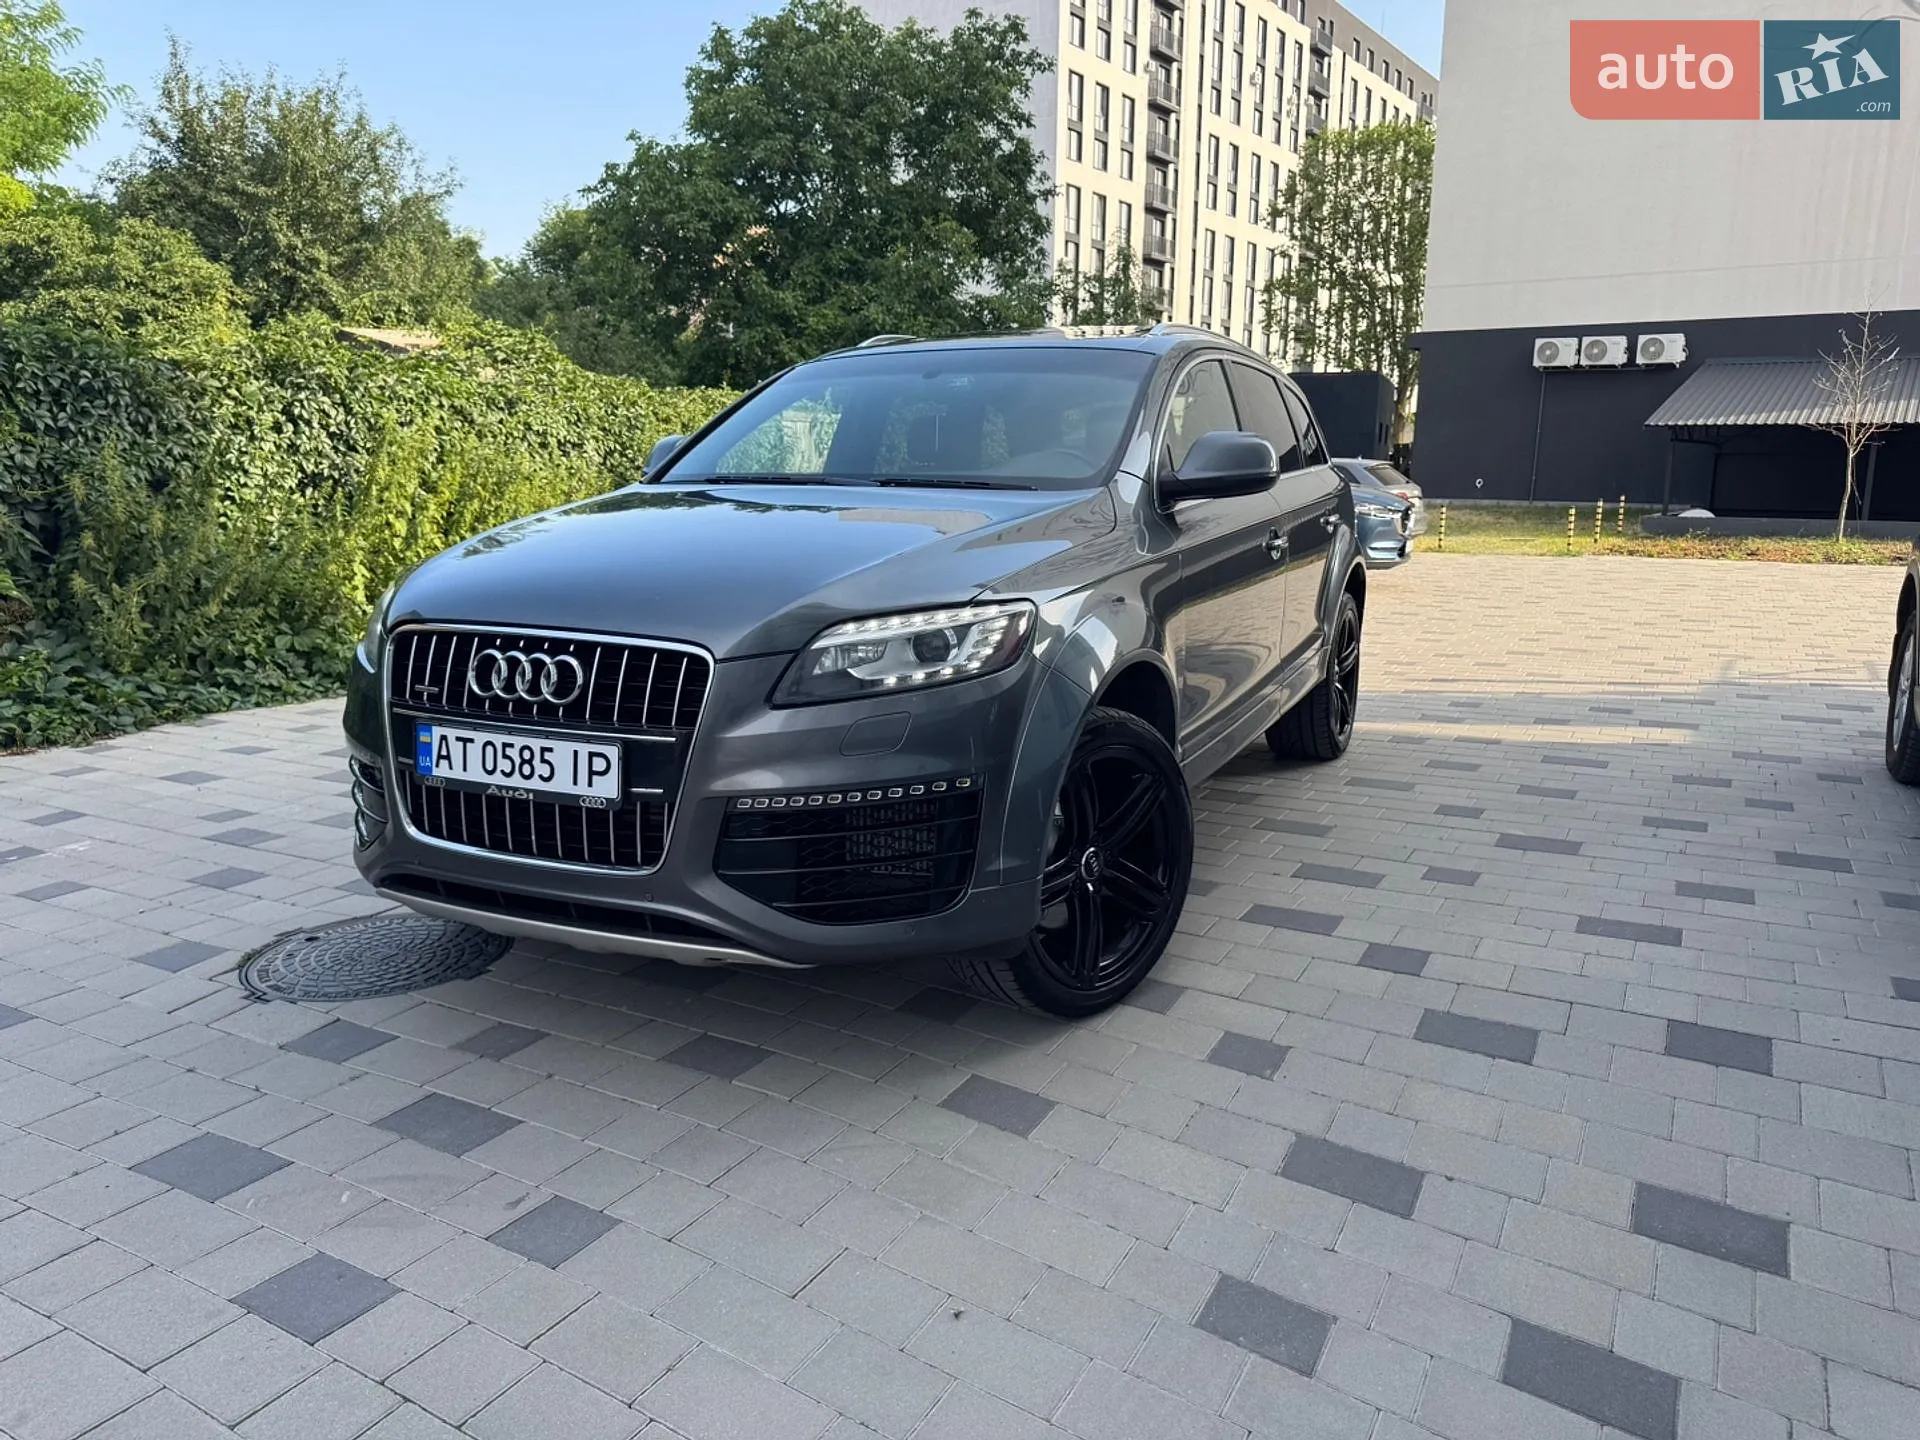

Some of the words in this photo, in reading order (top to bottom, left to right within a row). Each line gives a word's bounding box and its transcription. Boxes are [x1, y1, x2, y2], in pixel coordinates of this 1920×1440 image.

[419, 755, 432, 768] UA
[435, 734, 475, 773] AT
[481, 740, 555, 783] 0585
[572, 749, 612, 788] IP
